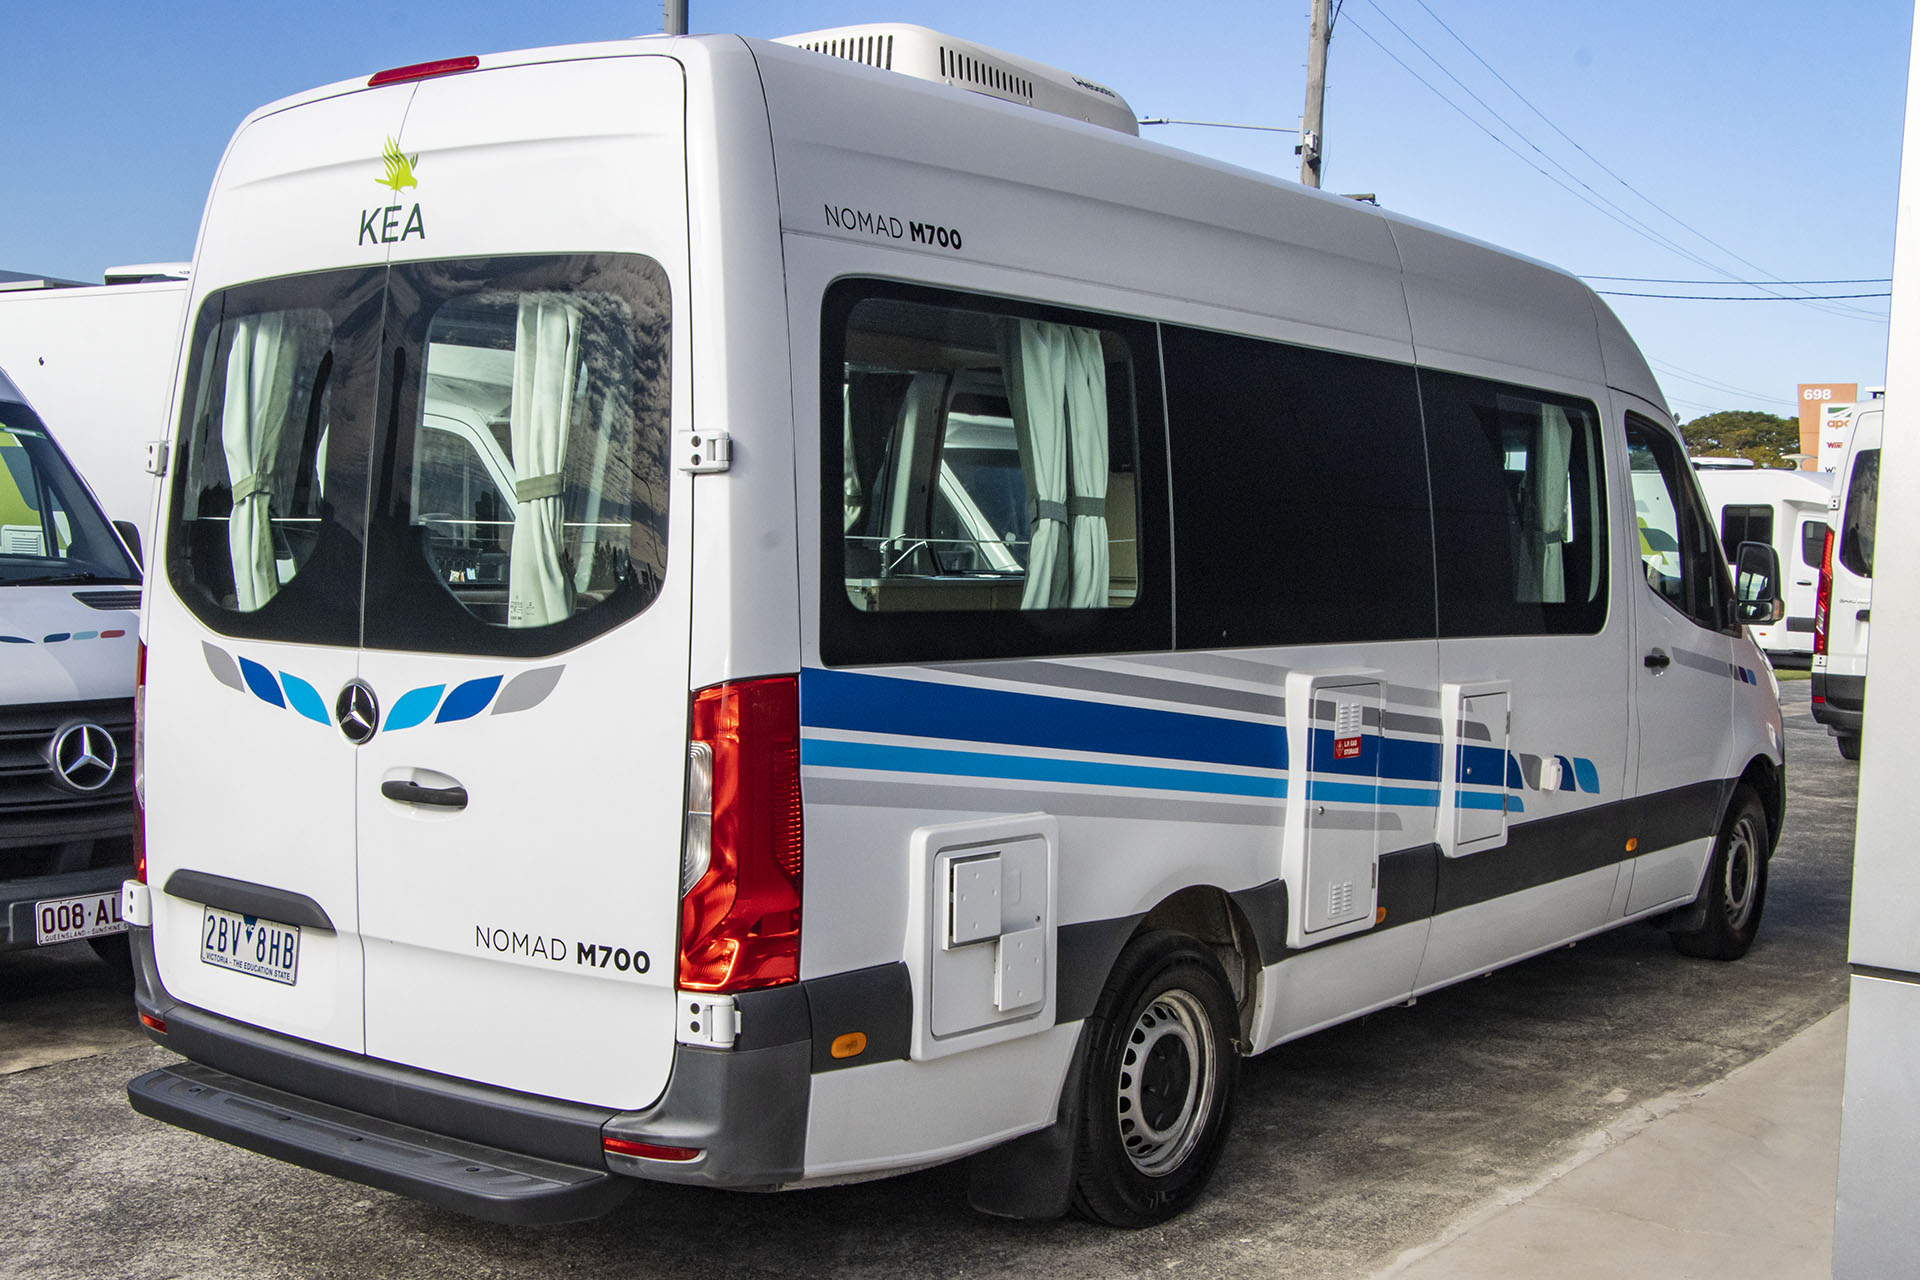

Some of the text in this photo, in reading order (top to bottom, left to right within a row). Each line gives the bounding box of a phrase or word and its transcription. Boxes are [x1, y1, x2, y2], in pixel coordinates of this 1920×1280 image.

[358, 202, 425, 246] KEA
[824, 203, 962, 250] NOMAD M700
[1803, 388, 1832, 401] 698
[206, 915, 241, 955] 2BV
[256, 927, 294, 969] 8HB
[475, 924, 651, 975] NOMAD M700
[206, 951, 290, 981] VICTORIA THE EDUCATION STATE
